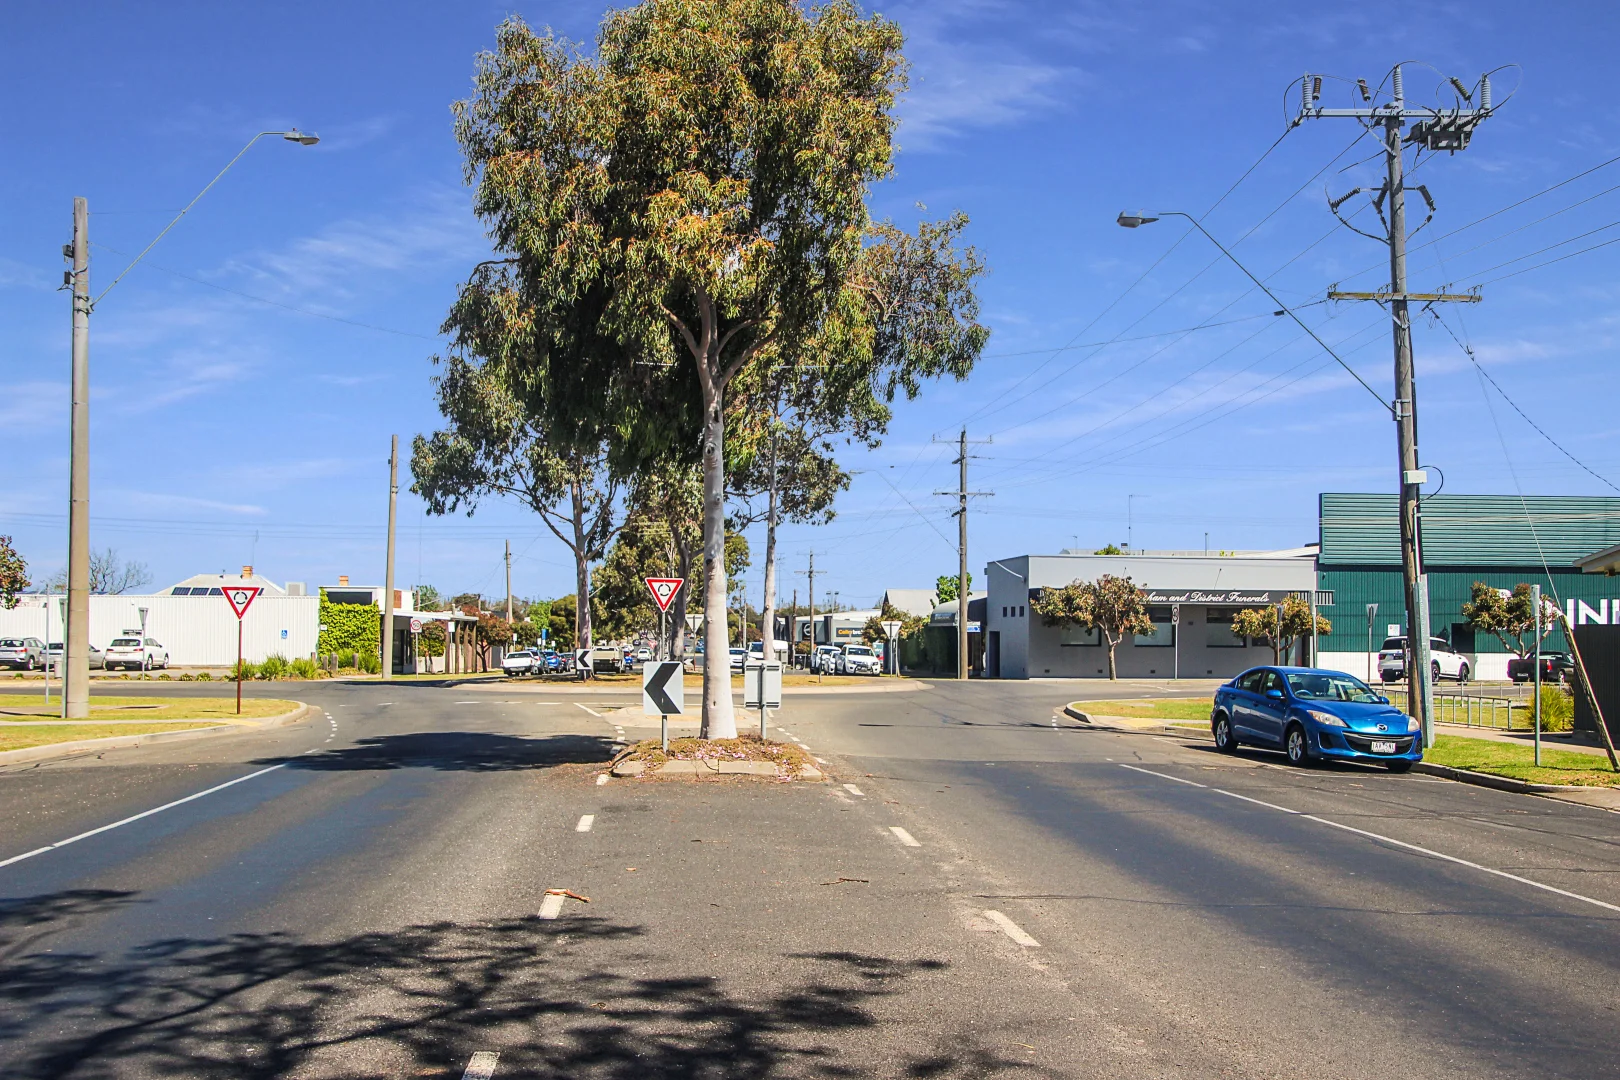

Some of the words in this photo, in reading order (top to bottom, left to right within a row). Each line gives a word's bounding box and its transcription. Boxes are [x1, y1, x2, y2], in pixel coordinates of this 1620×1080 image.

[1169, 592, 1190, 602] and
[1190, 591, 1224, 602] District
[1226, 591, 1269, 602] Funerals
